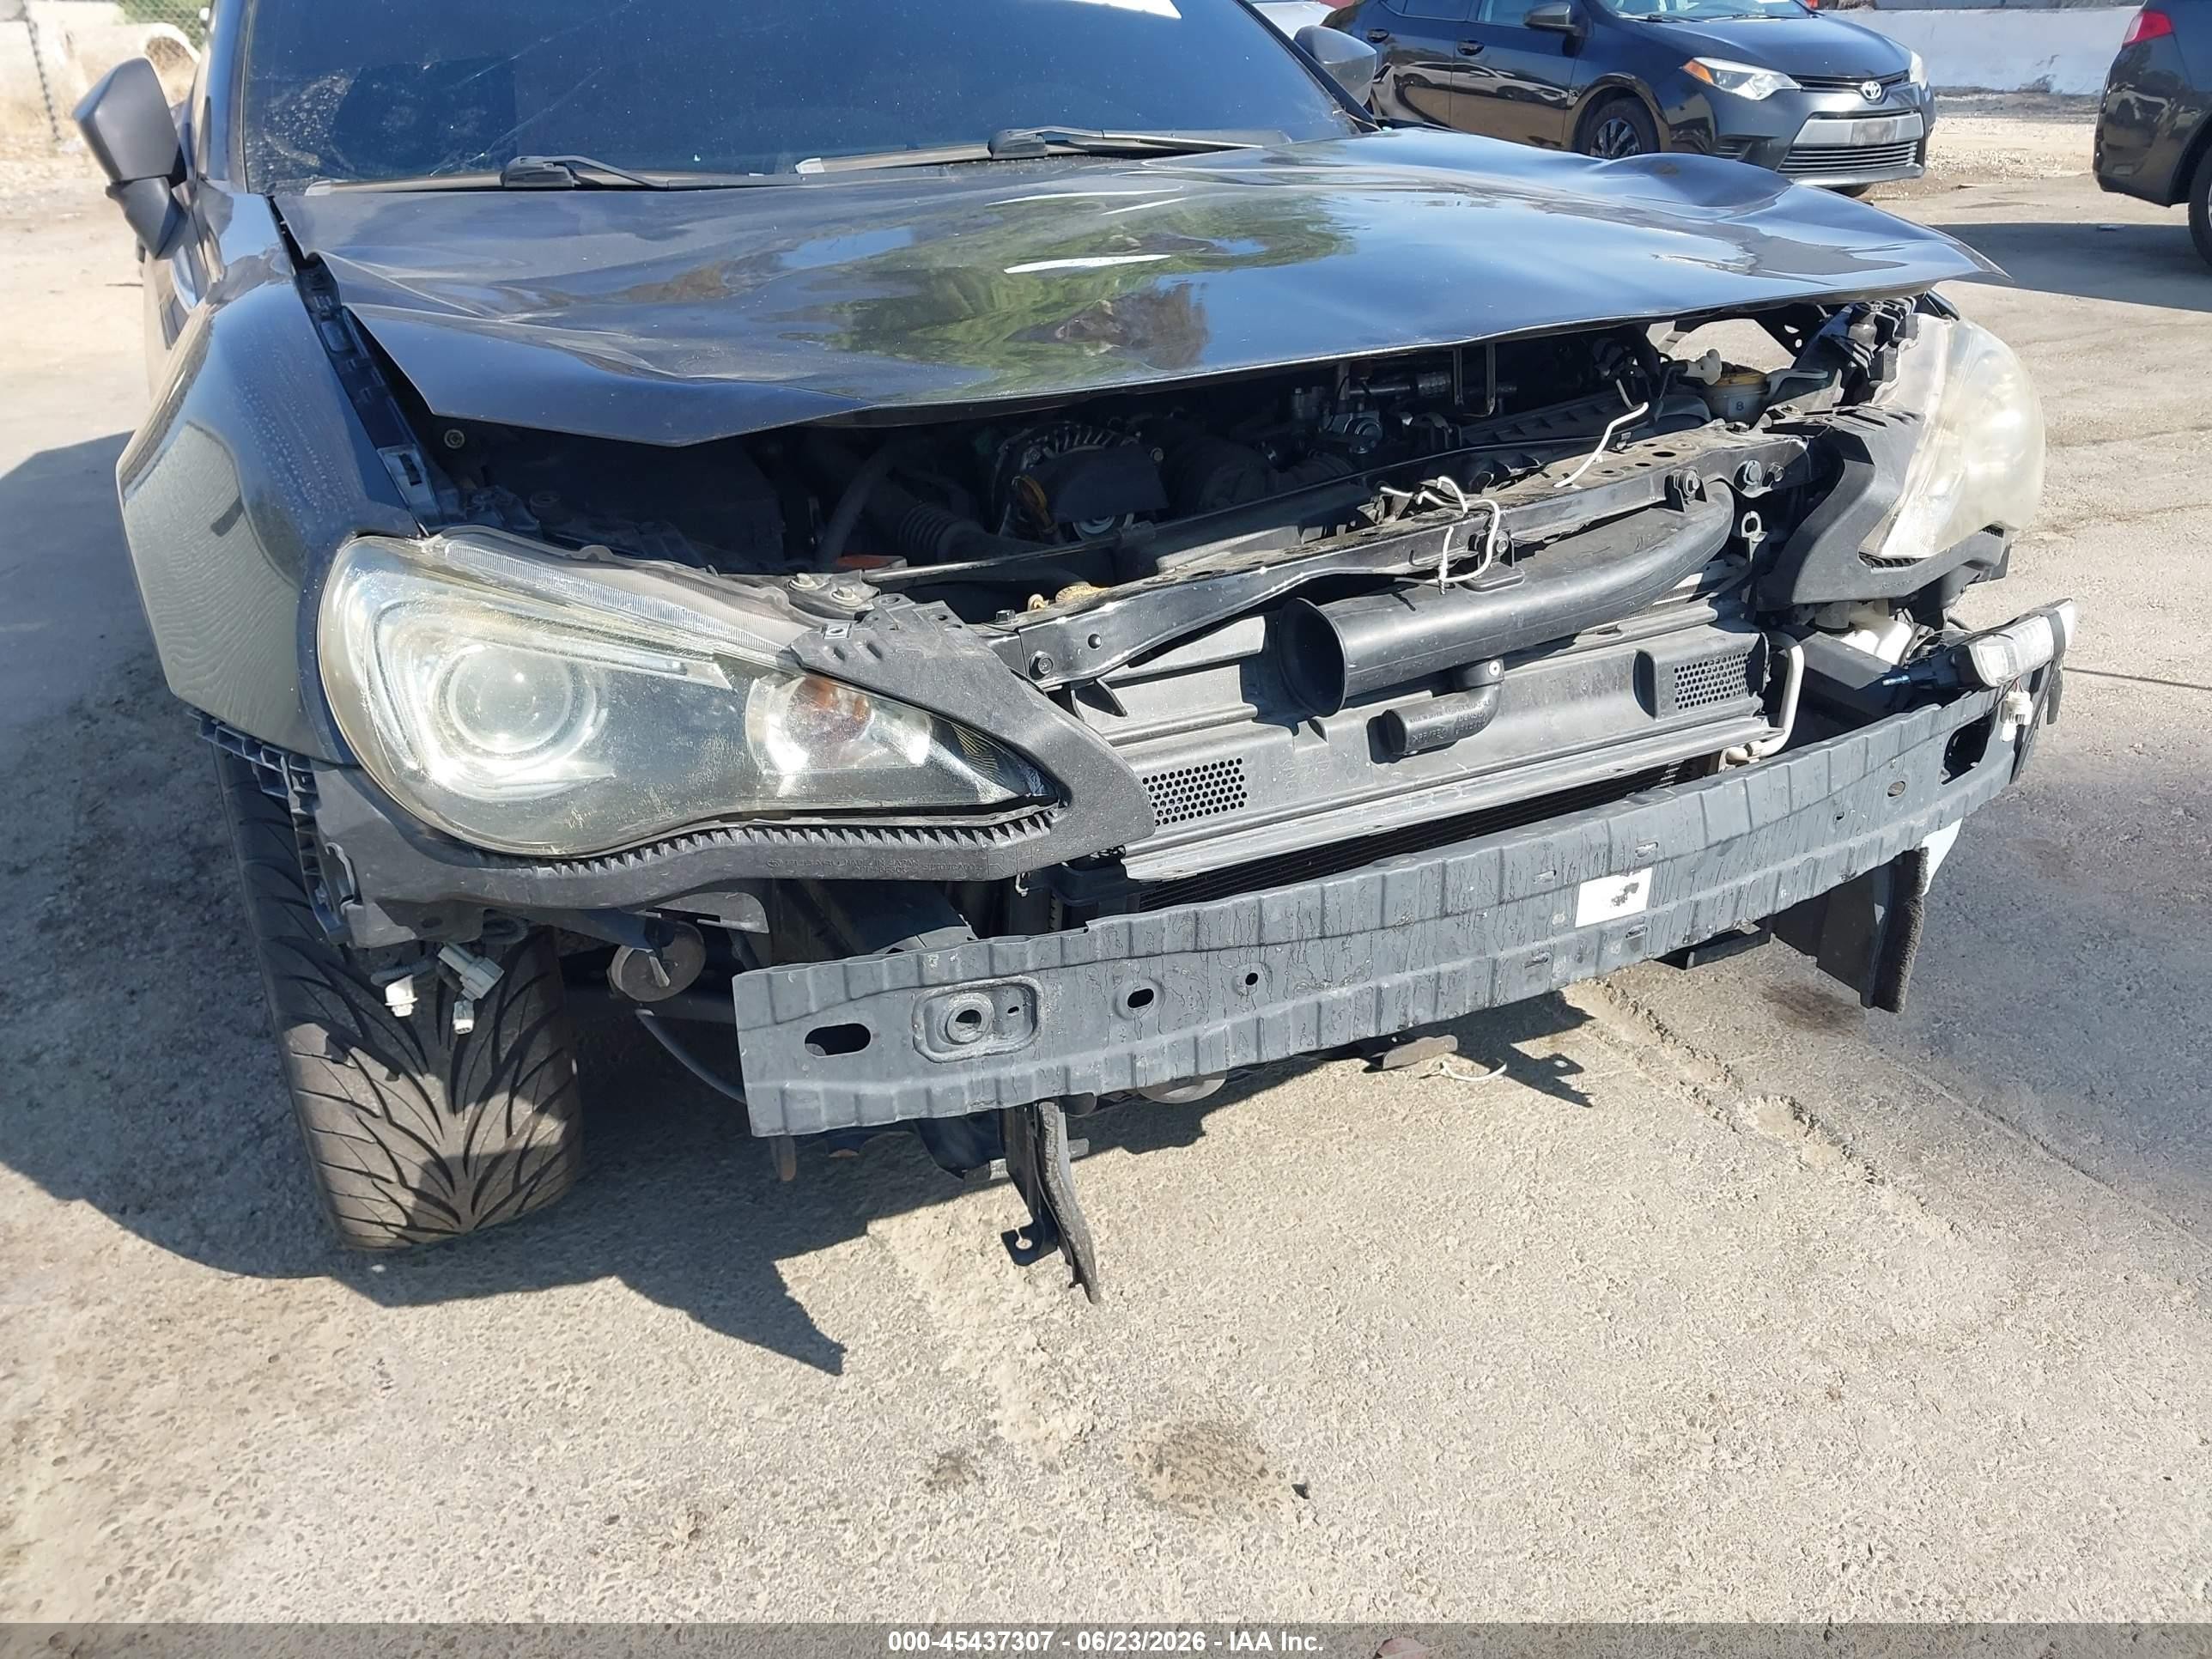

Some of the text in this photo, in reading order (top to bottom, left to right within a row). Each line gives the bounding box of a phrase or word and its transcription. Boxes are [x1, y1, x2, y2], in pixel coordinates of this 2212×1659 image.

[1736, 400, 1745, 411] 8
[845, 858, 872, 866] MADE
[888, 859, 920, 867] JAPAN
